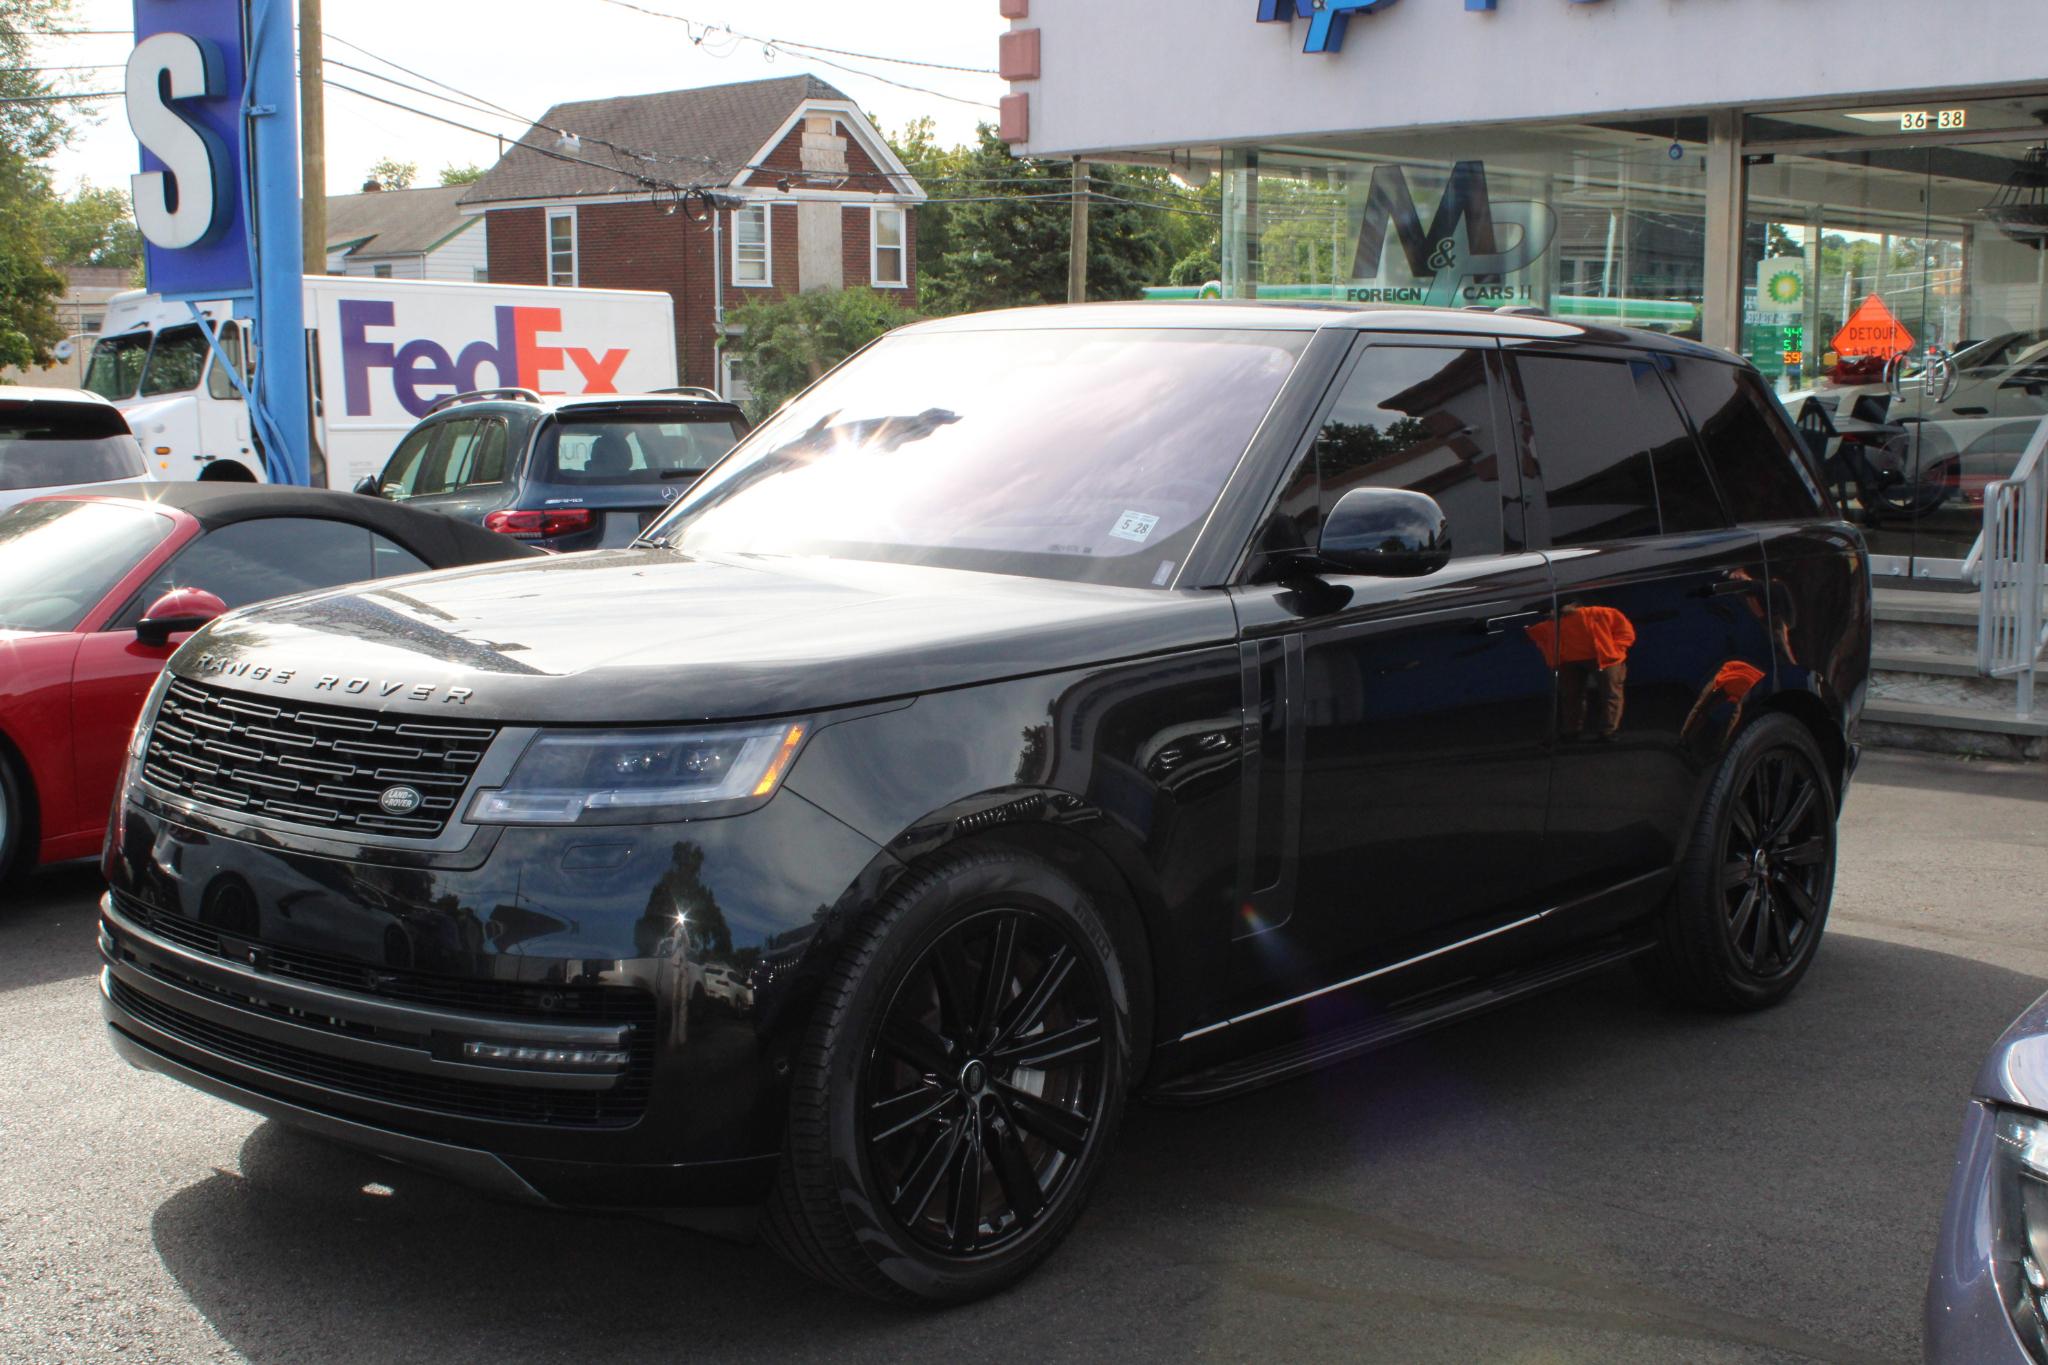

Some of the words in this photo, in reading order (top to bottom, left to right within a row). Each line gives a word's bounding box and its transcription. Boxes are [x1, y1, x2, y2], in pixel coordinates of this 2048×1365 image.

[125, 32, 213, 250] S
[1347, 288, 1421, 302] FOREIGN
[1463, 286, 1514, 300] CARS
[1849, 327, 1897, 340] DETOUR
[338, 299, 631, 420] FedEx
[1121, 519, 1133, 530] 5
[1134, 522, 1149, 534] 28
[193, 654, 296, 685] RANGE
[314, 674, 473, 704] ROVER
